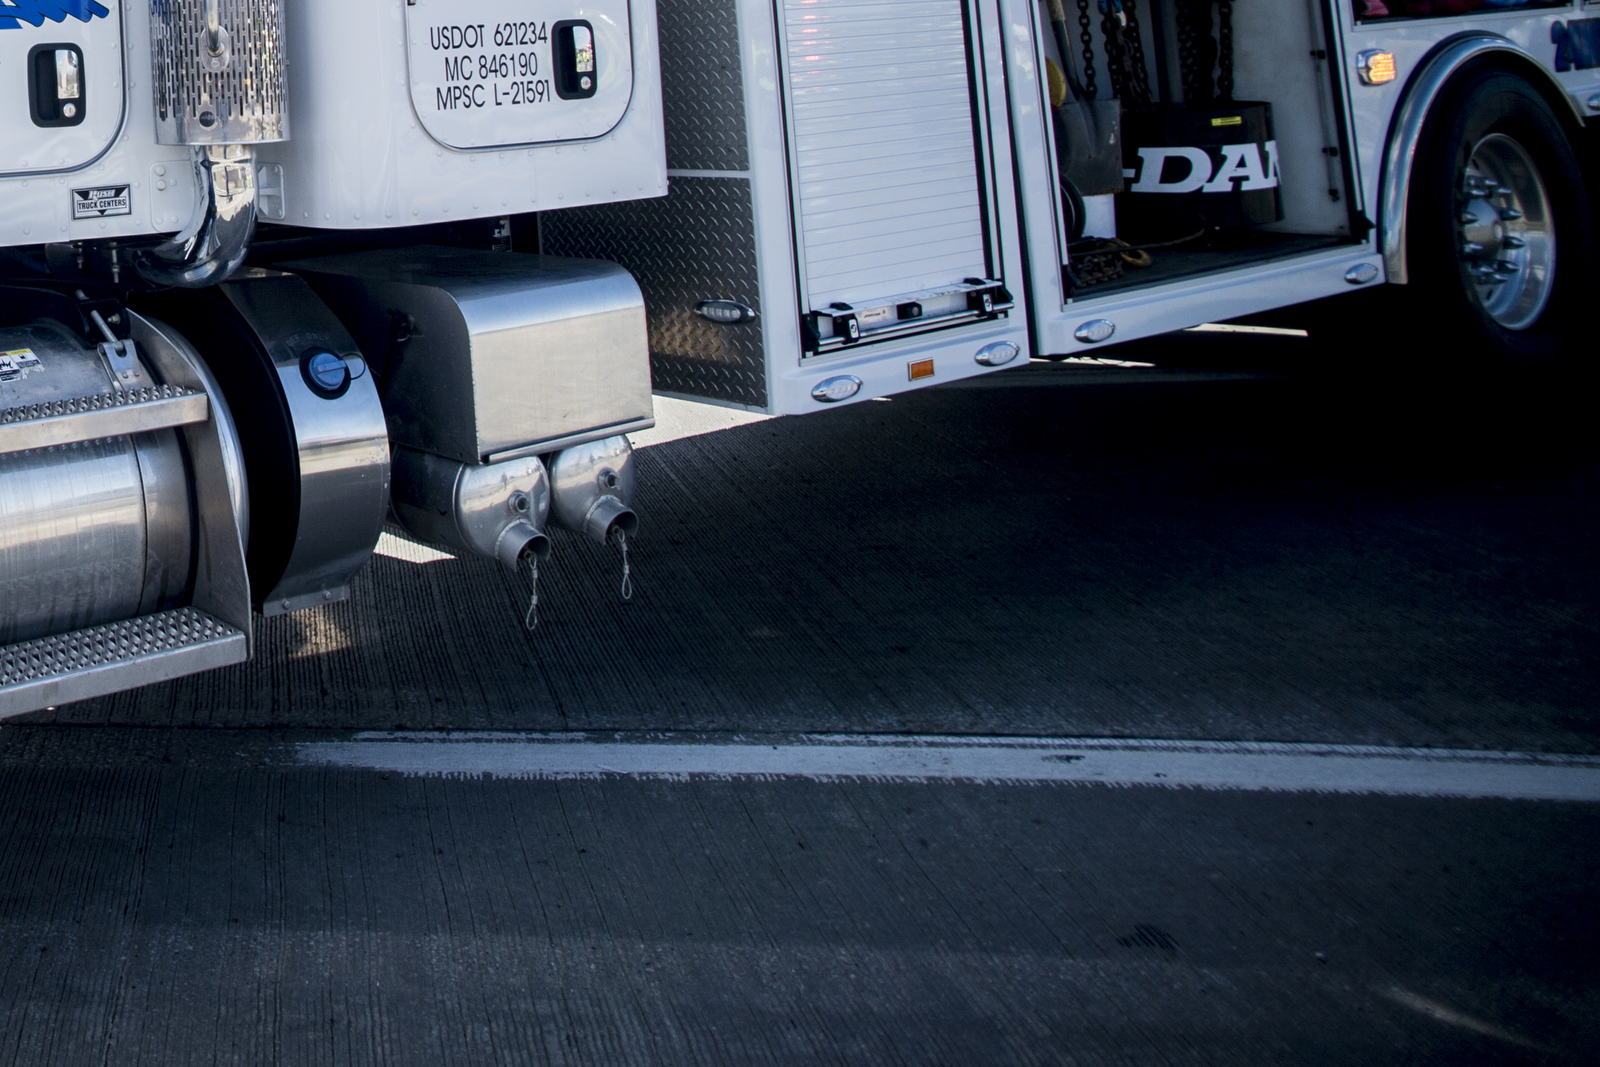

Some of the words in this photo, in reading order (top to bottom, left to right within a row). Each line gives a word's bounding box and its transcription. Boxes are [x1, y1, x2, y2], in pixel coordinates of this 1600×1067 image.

[430, 24, 485, 50] USDOT
[493, 21, 548, 47] 621234
[445, 56, 473, 82] MC
[478, 52, 538, 80] 846190
[436, 84, 486, 110] MPSC
[494, 79, 551, 106] L-21591
[78, 201, 98, 210] TRUCK
[99, 199, 126, 208] CENTERS
